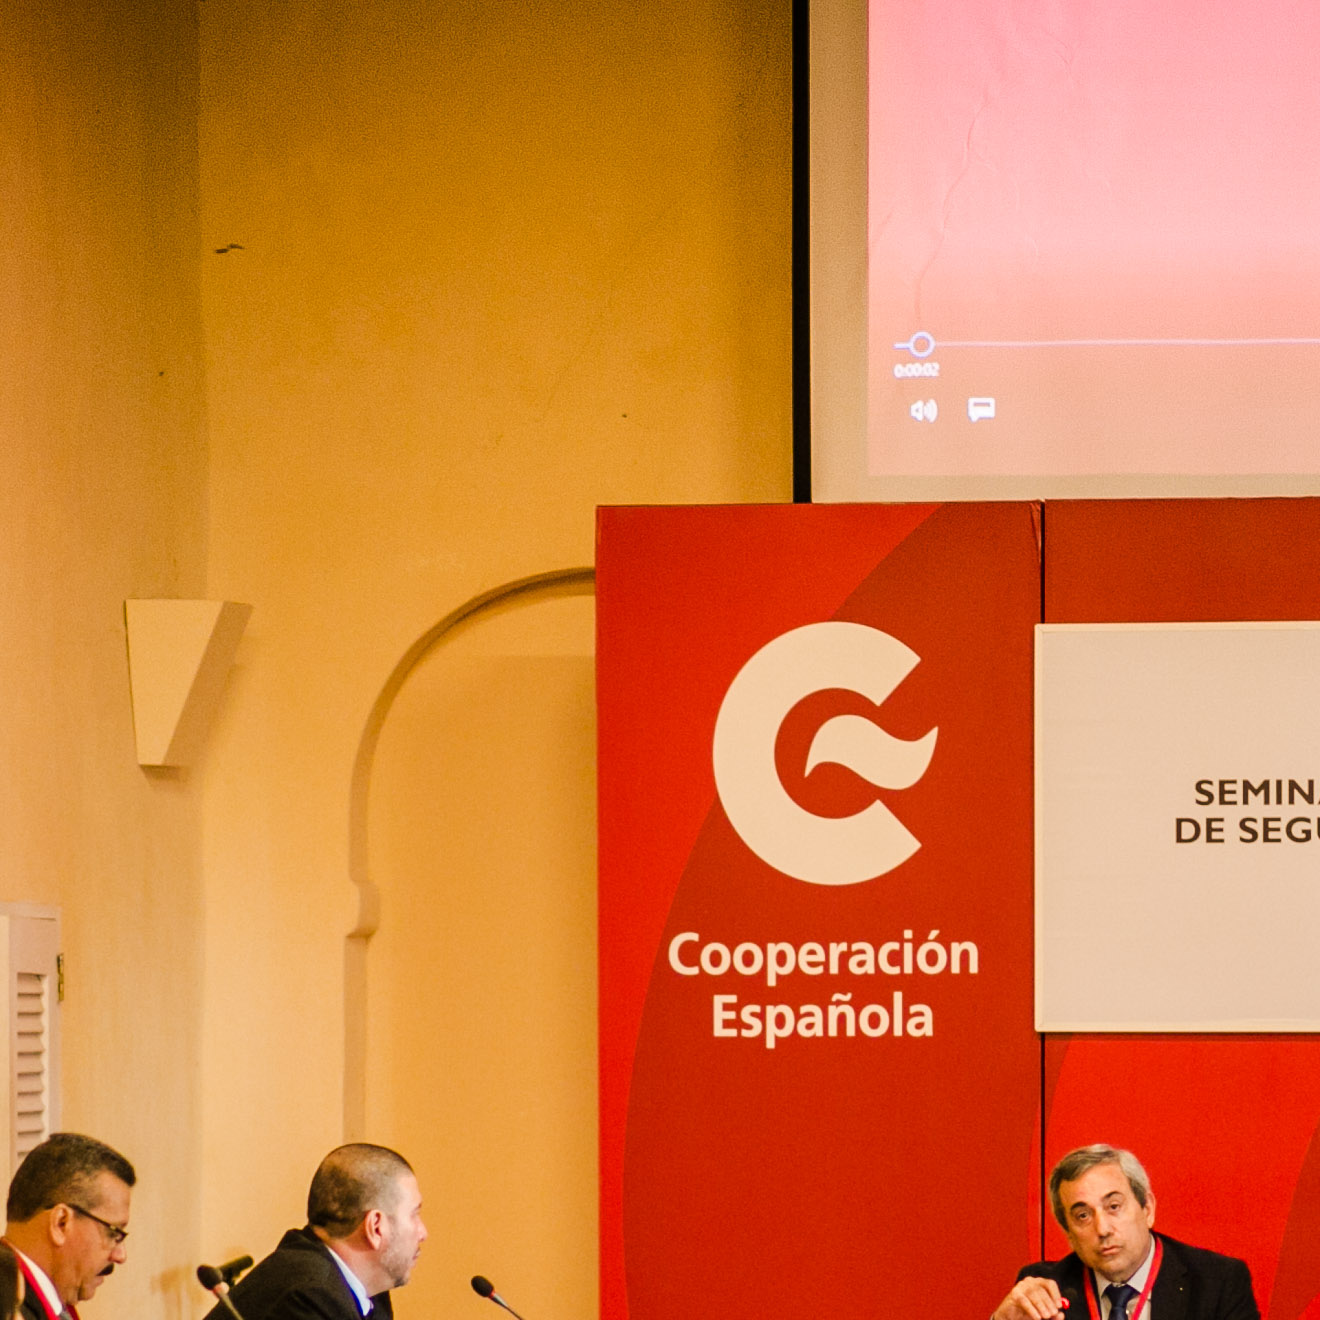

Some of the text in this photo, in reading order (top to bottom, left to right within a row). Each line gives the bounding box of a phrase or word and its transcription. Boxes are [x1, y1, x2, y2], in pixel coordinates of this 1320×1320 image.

[1176, 817, 1225, 844] DE
[668, 929, 979, 987] Cooperación
[713, 991, 934, 1049] Española
